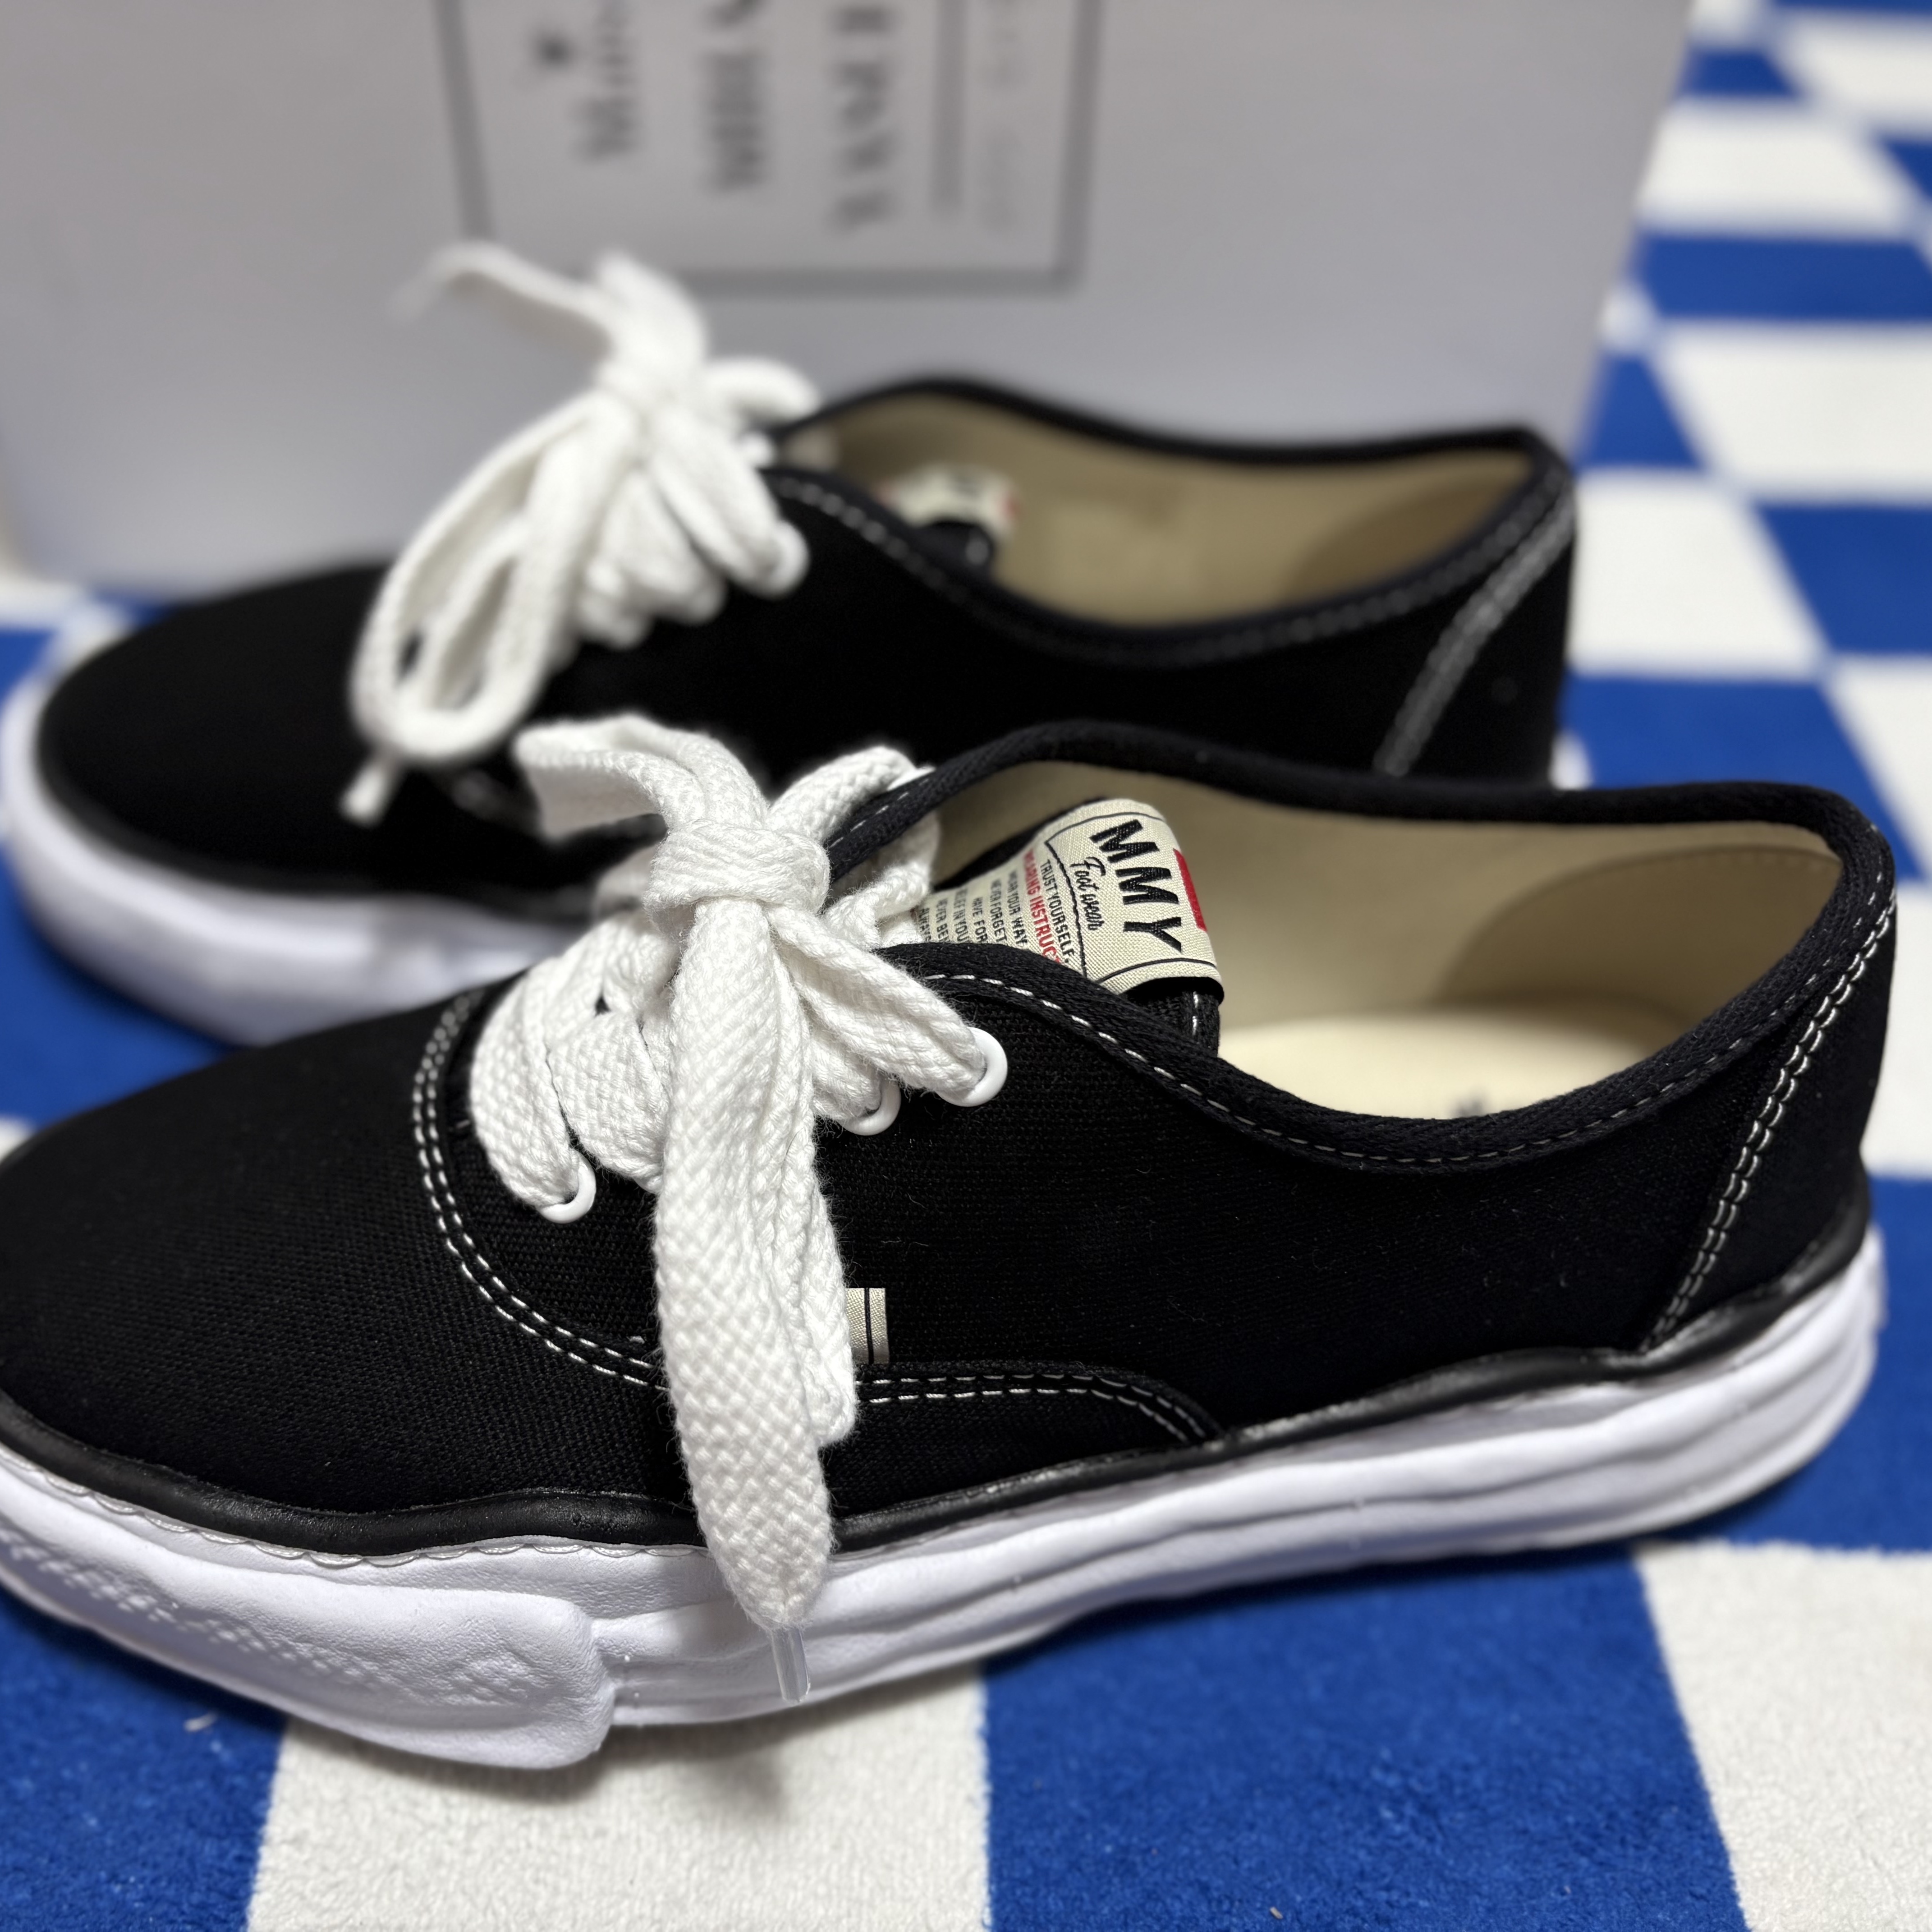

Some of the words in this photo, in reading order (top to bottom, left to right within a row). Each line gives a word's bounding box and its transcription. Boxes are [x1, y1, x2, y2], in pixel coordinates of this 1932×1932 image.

[1041, 859, 1058, 892] TRUST
[1069, 856, 1106, 891] Foot
[1089, 819, 1182, 953] MMY
[1007, 891, 1021, 915] YOUR
[990, 902, 1008, 942] FORGET
[1011, 915, 1028, 945] WAY
[1047, 891, 1074, 963] YOURSELF.
